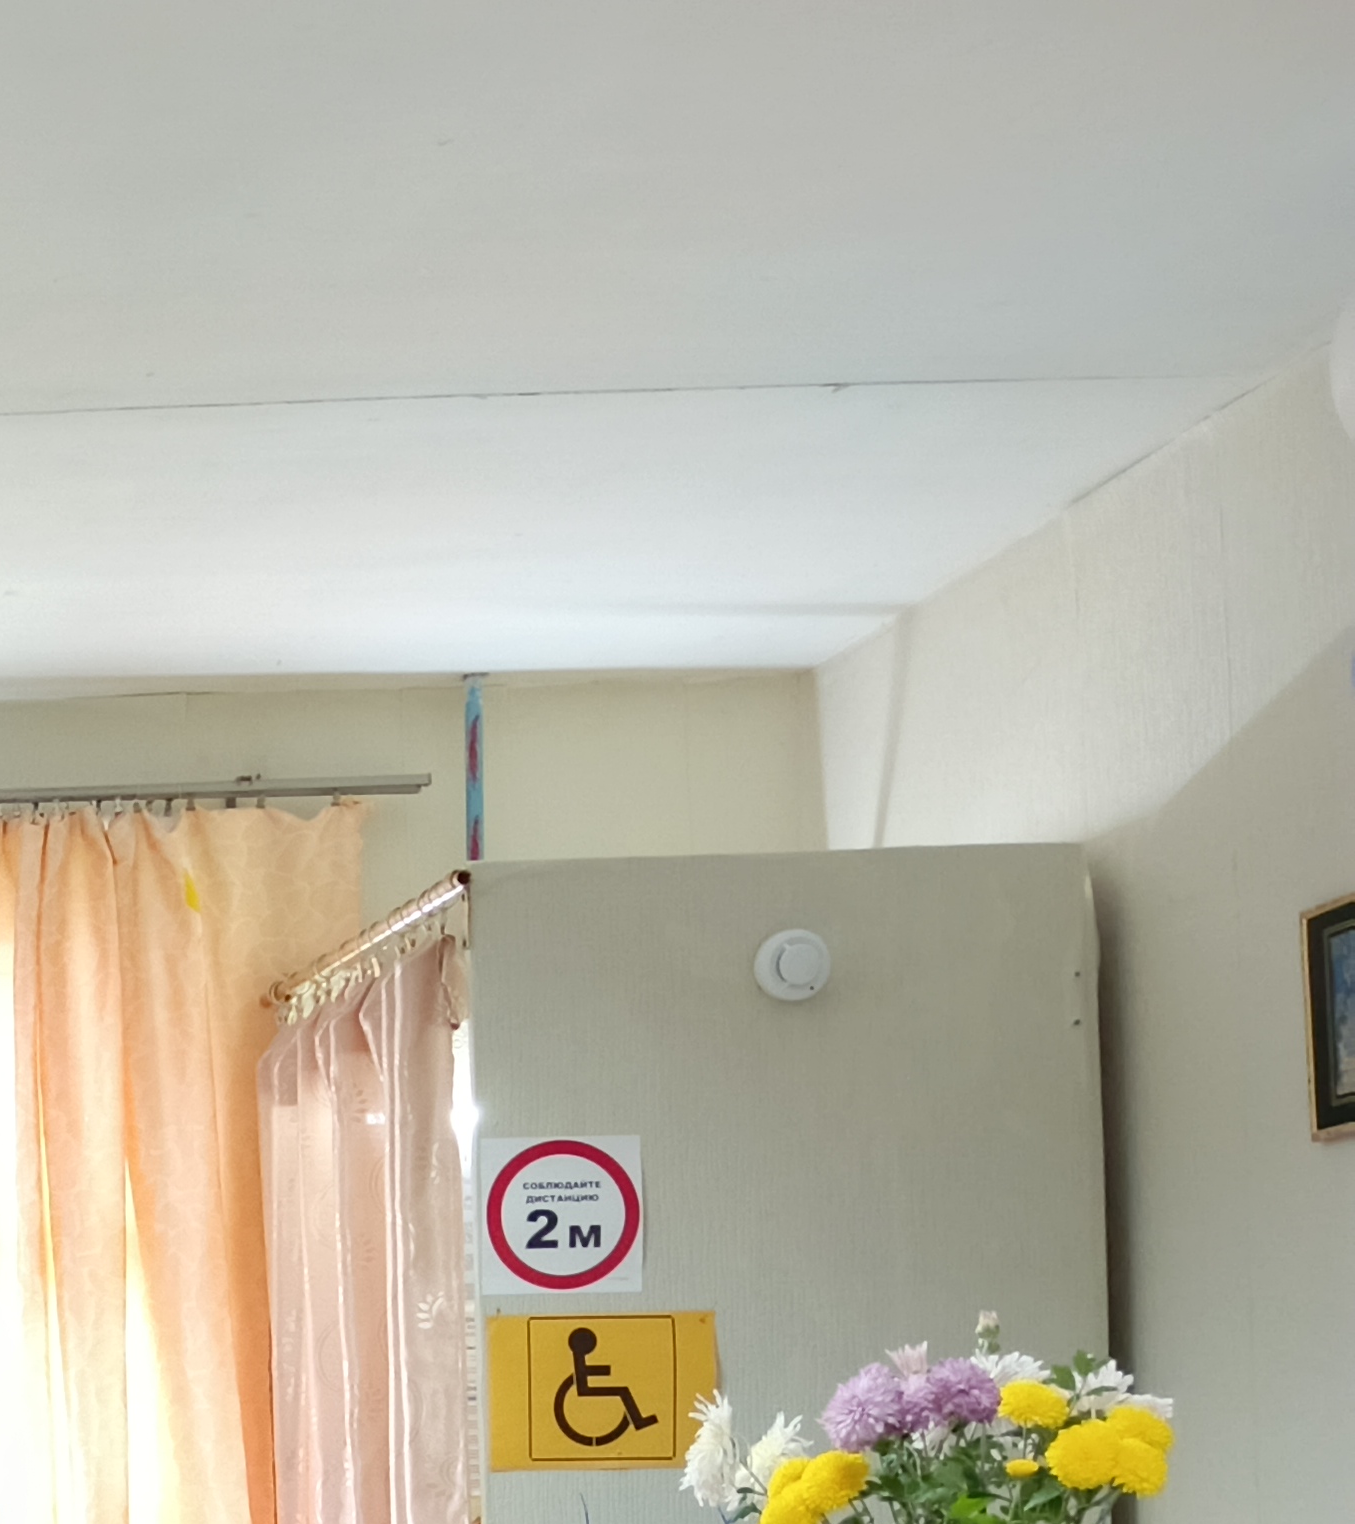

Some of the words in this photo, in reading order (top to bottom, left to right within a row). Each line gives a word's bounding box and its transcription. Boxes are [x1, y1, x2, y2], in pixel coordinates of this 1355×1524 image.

[522, 1181, 601, 1190] СОБЛЮДАЙТЕ
[525, 1194, 599, 1204] ДИСТАНЦИЮ
[525, 1208, 559, 1249] 2
